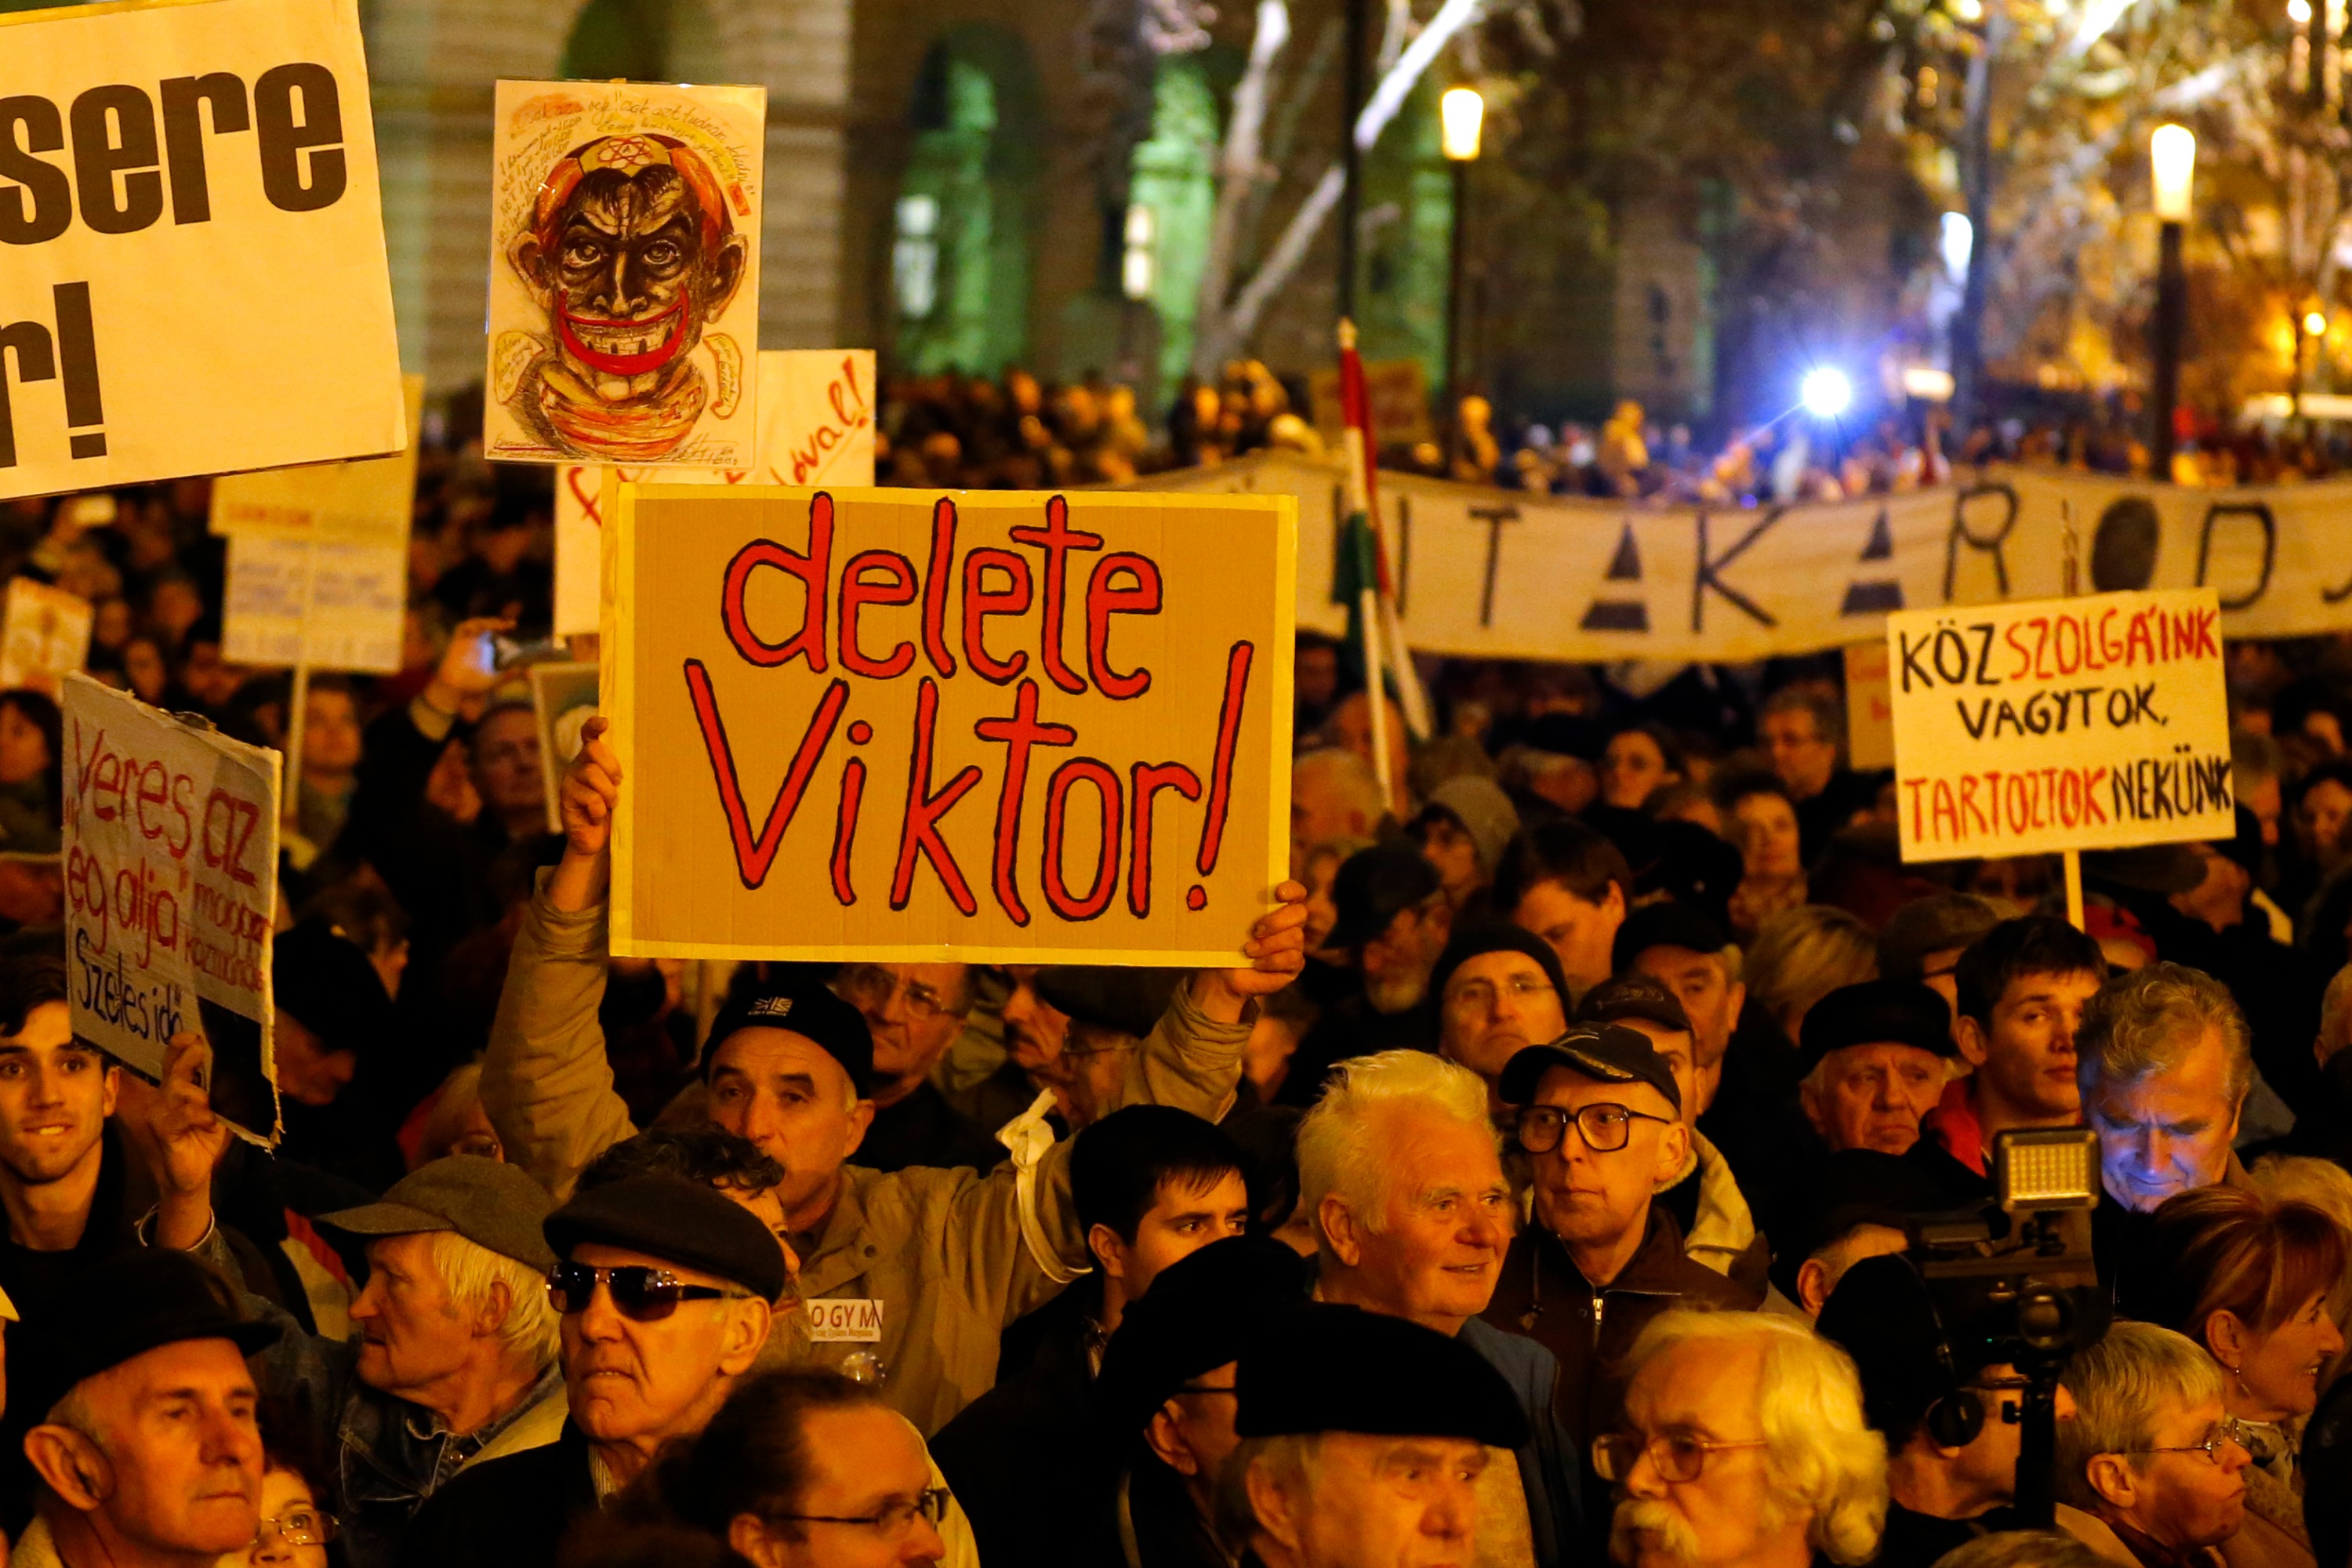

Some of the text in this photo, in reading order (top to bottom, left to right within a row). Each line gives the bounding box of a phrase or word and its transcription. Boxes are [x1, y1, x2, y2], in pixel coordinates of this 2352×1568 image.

[720, 491, 1163, 700] delete
[1468, 483, 2352, 633] TAKAROD
[1957, 681, 2168, 741] VAGYTOK,
[202, 787, 260, 888] az
[684, 640, 1254, 927] Viktor!
[77, 927, 149, 1040] Szeles
